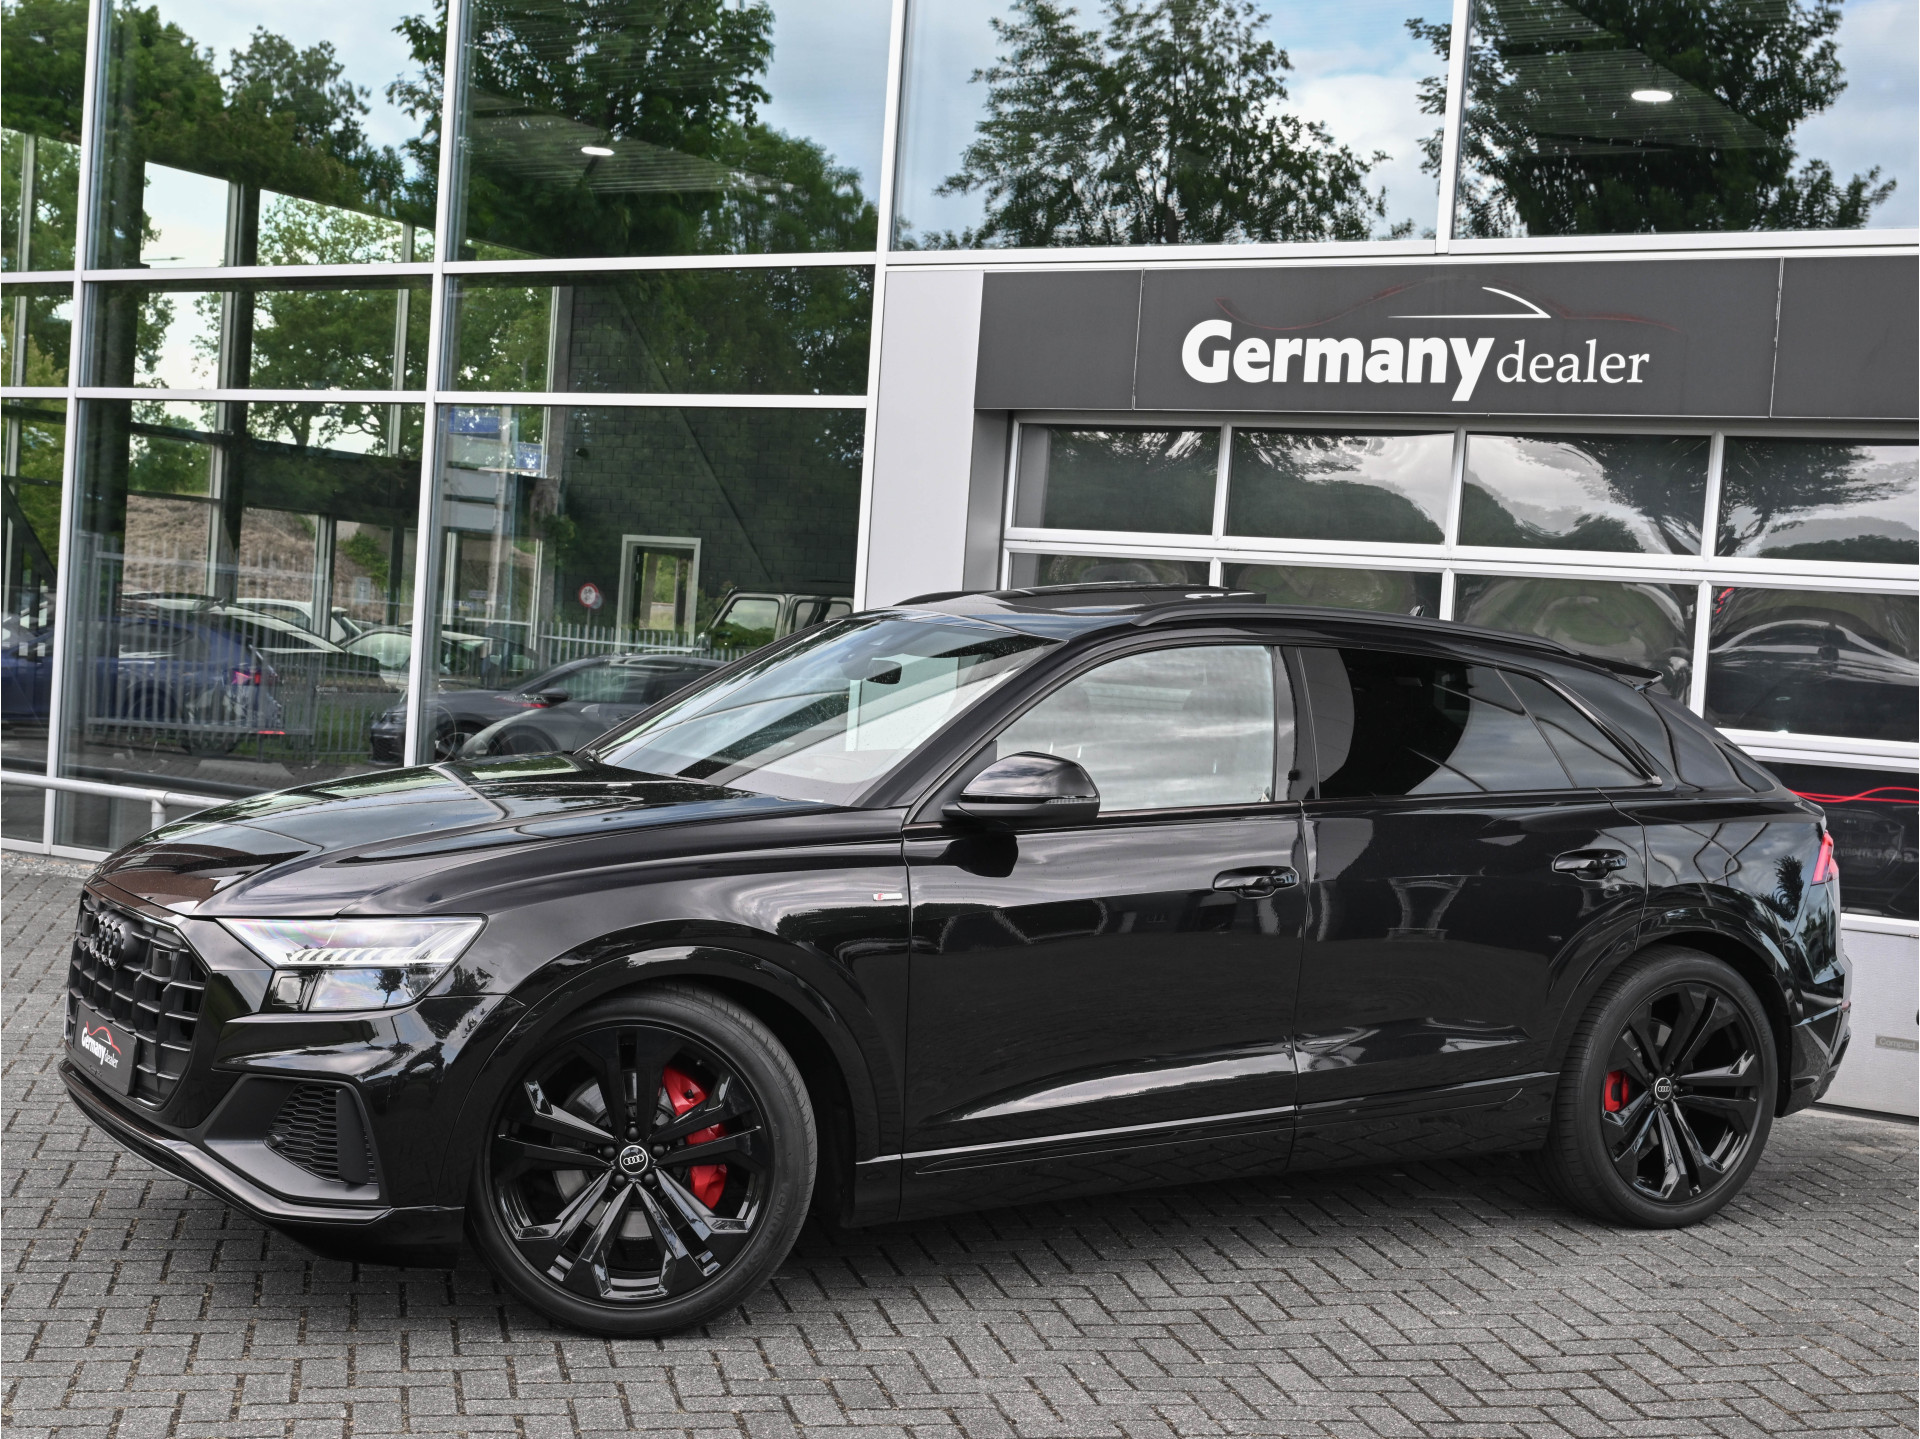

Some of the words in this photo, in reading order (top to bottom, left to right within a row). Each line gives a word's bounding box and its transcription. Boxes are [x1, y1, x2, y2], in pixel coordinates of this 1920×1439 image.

[1182, 319, 1495, 401] Germany
[1496, 339, 1650, 384] dealer
[81, 1026, 106, 1065] Germany
[104, 1049, 119, 1068] dealer
[1879, 1037, 1916, 1050] Compact
